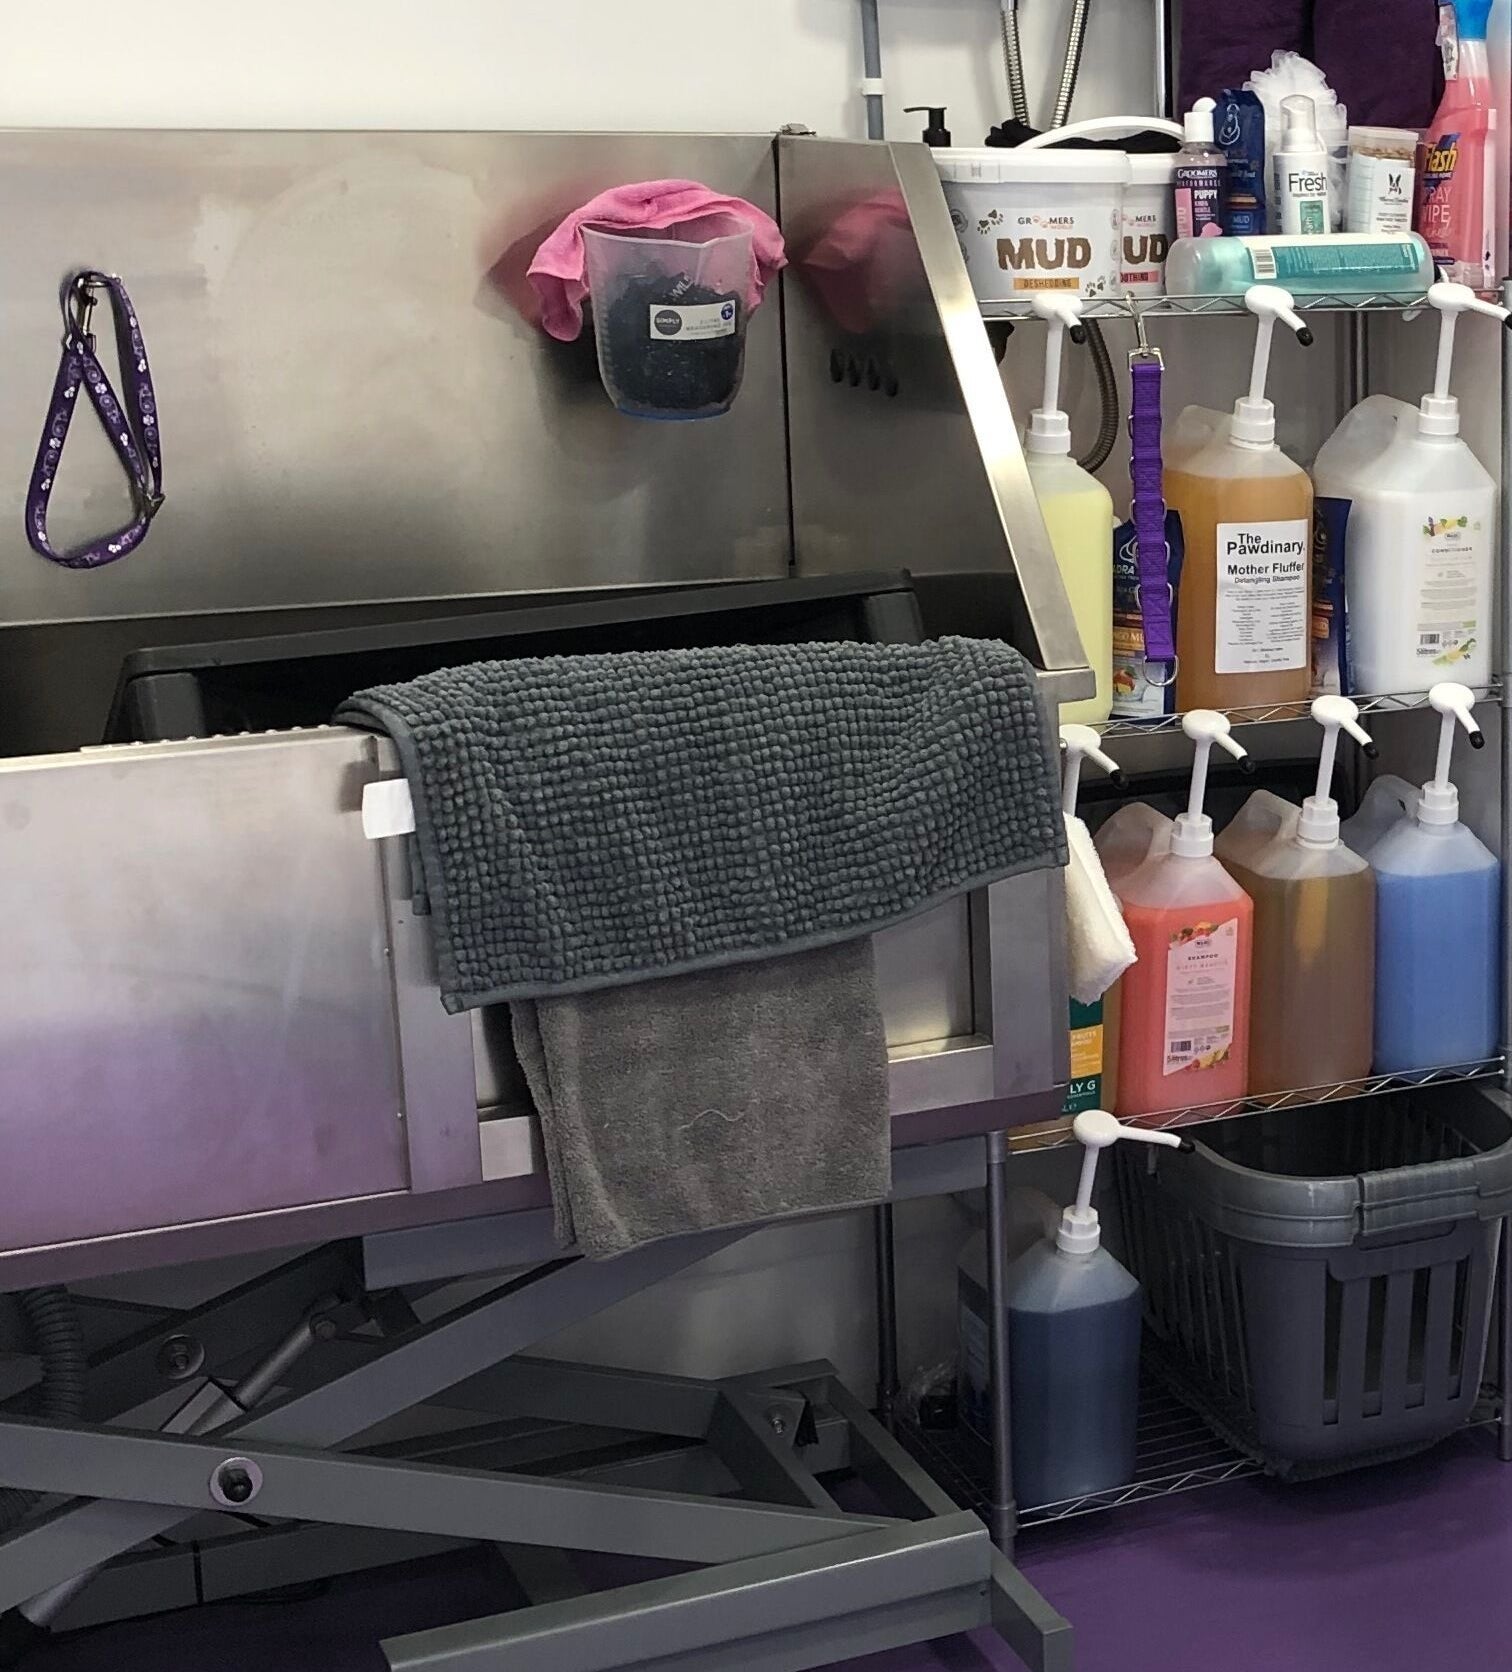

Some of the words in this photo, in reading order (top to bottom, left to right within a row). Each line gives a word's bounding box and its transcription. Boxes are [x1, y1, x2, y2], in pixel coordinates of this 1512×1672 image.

[1177, 168, 1217, 179] GROOMERS
[1288, 171, 1328, 193] Fresh
[1194, 189, 1218, 200] PUPPY
[1425, 186, 1452, 202] PRAY
[996, 237, 1092, 271] MUD
[1123, 234, 1169, 265] UD
[1023, 278, 1072, 288] DESHEDDING
[1238, 532, 1262, 545] The
[1227, 563, 1270, 576] Mother
[1272, 561, 1305, 574] Fluffer
[1234, 577, 1271, 585] Detangling
[1272, 574, 1301, 583] Shampoo
[1187, 953, 1219, 961] SHAMPOO
